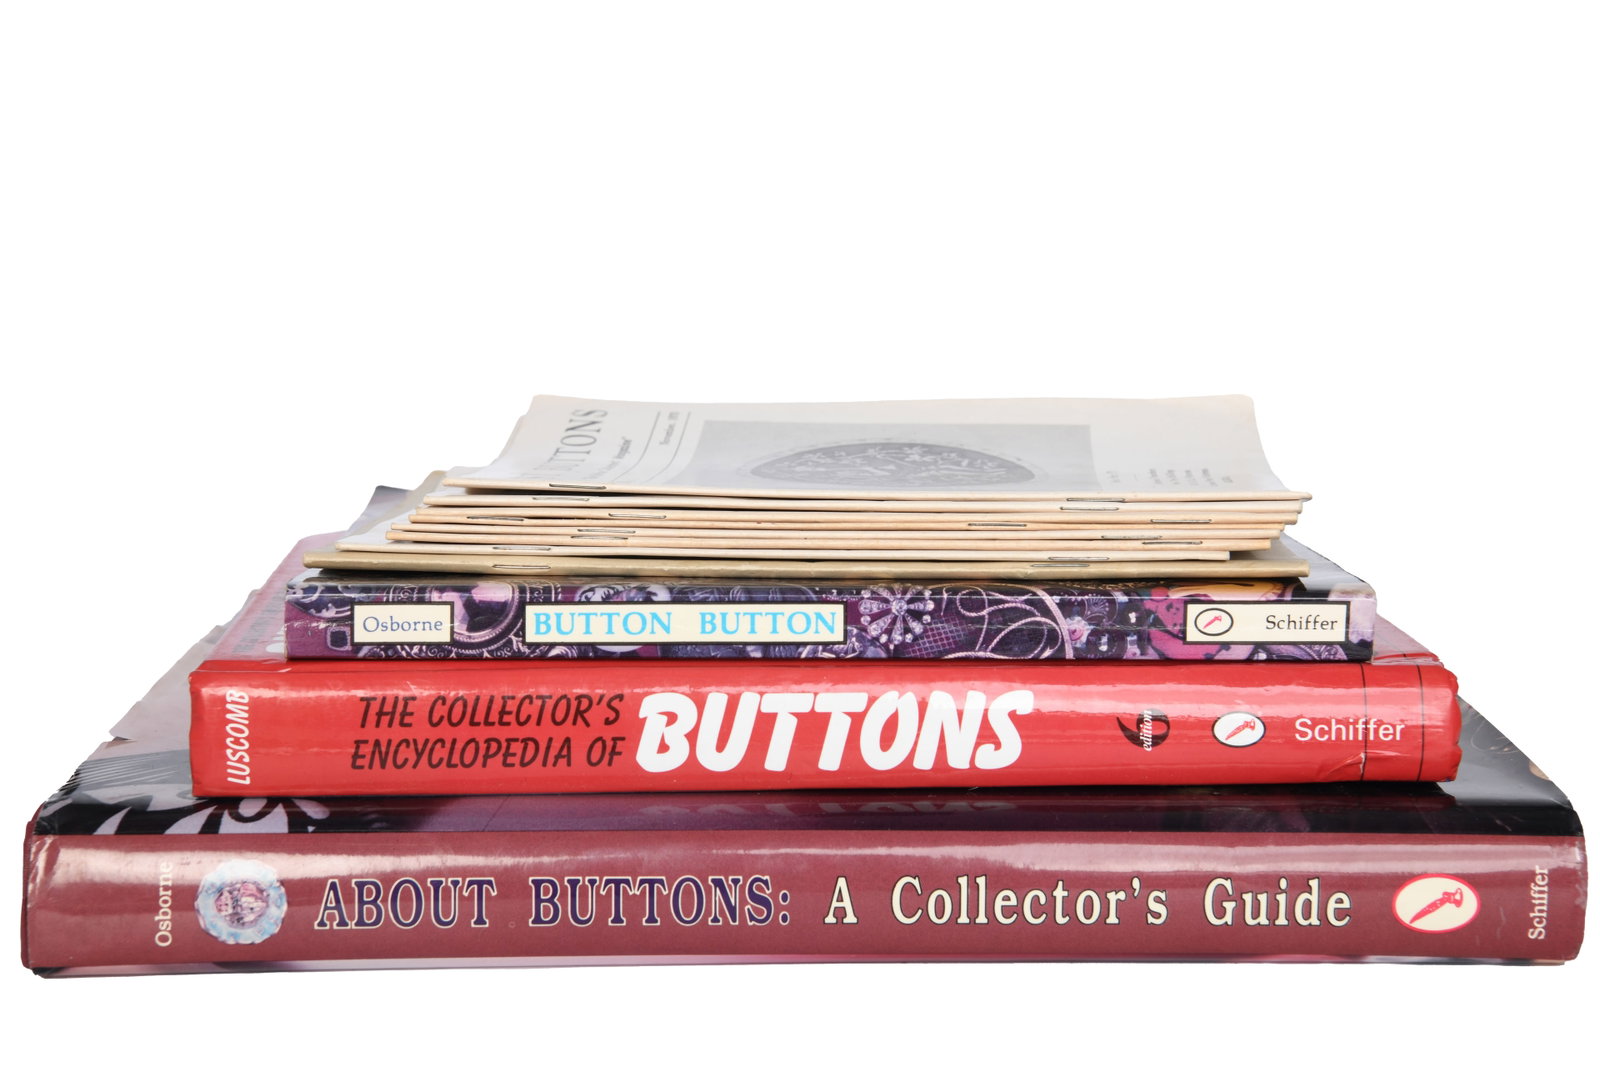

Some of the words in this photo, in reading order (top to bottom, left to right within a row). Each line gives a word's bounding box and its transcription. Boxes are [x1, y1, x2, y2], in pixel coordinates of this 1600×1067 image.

[362, 615, 443, 634] Osborne
[533, 610, 673, 636] BUTTON
[699, 610, 837, 636] BUTTON
[1265, 614, 1338, 632] Schiffer
[359, 695, 418, 729] THE
[427, 693, 624, 728] COLLECTOR'S
[1294, 718, 1405, 742] Schiffer
[226, 689, 250, 786] LUSCOMB
[635, 690, 1034, 773] BUTTONS
[1139, 710, 1153, 752] edition
[350, 737, 573, 771] ENCYCLOPEDIA
[585, 737, 626, 767] OF
[154, 861, 173, 947] Osborne
[314, 878, 498, 930] ABOUT
[528, 876, 792, 928] BUTTONS:
[823, 876, 859, 925] A
[890, 875, 1168, 927] Collector's
[1203, 877, 1352, 927] Guide
[1527, 865, 1549, 940] Schiffer
